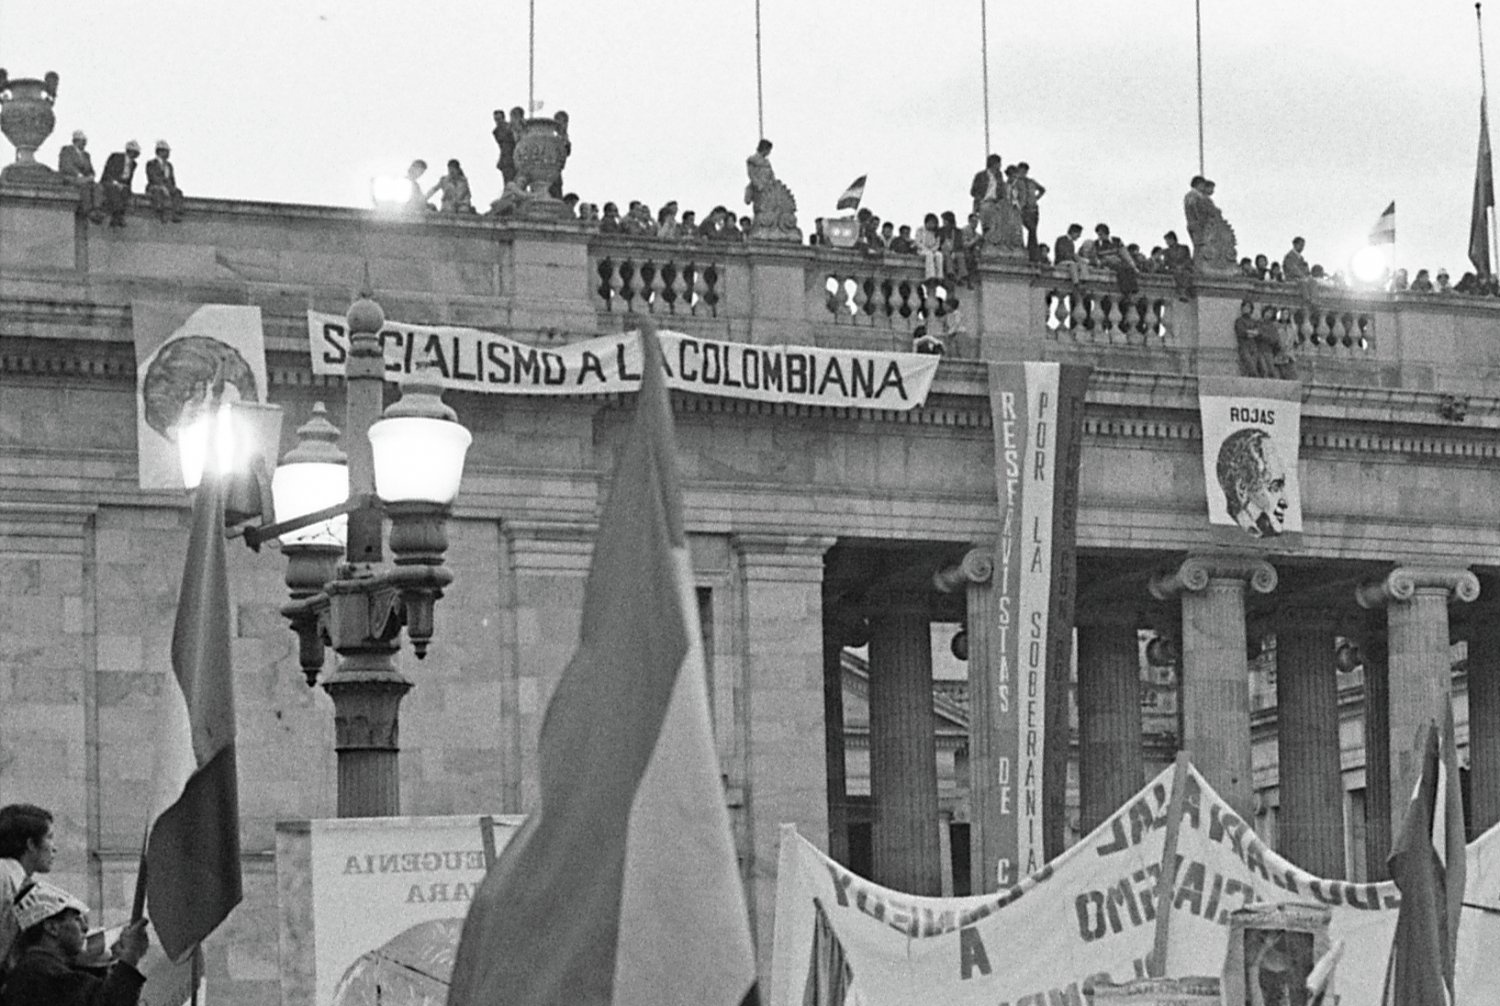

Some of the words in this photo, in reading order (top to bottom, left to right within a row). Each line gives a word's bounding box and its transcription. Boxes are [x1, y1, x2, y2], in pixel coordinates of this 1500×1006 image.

[323, 323, 566, 386] SCIALISMO
[577, 351, 607, 386] A
[679, 339, 908, 400] COLOMBIANA
[1034, 391, 1048, 481] POR
[1230, 407, 1275, 425] ROJAS
[1031, 516, 1042, 574] LA
[1025, 611, 1042, 874] SOBERANIA
